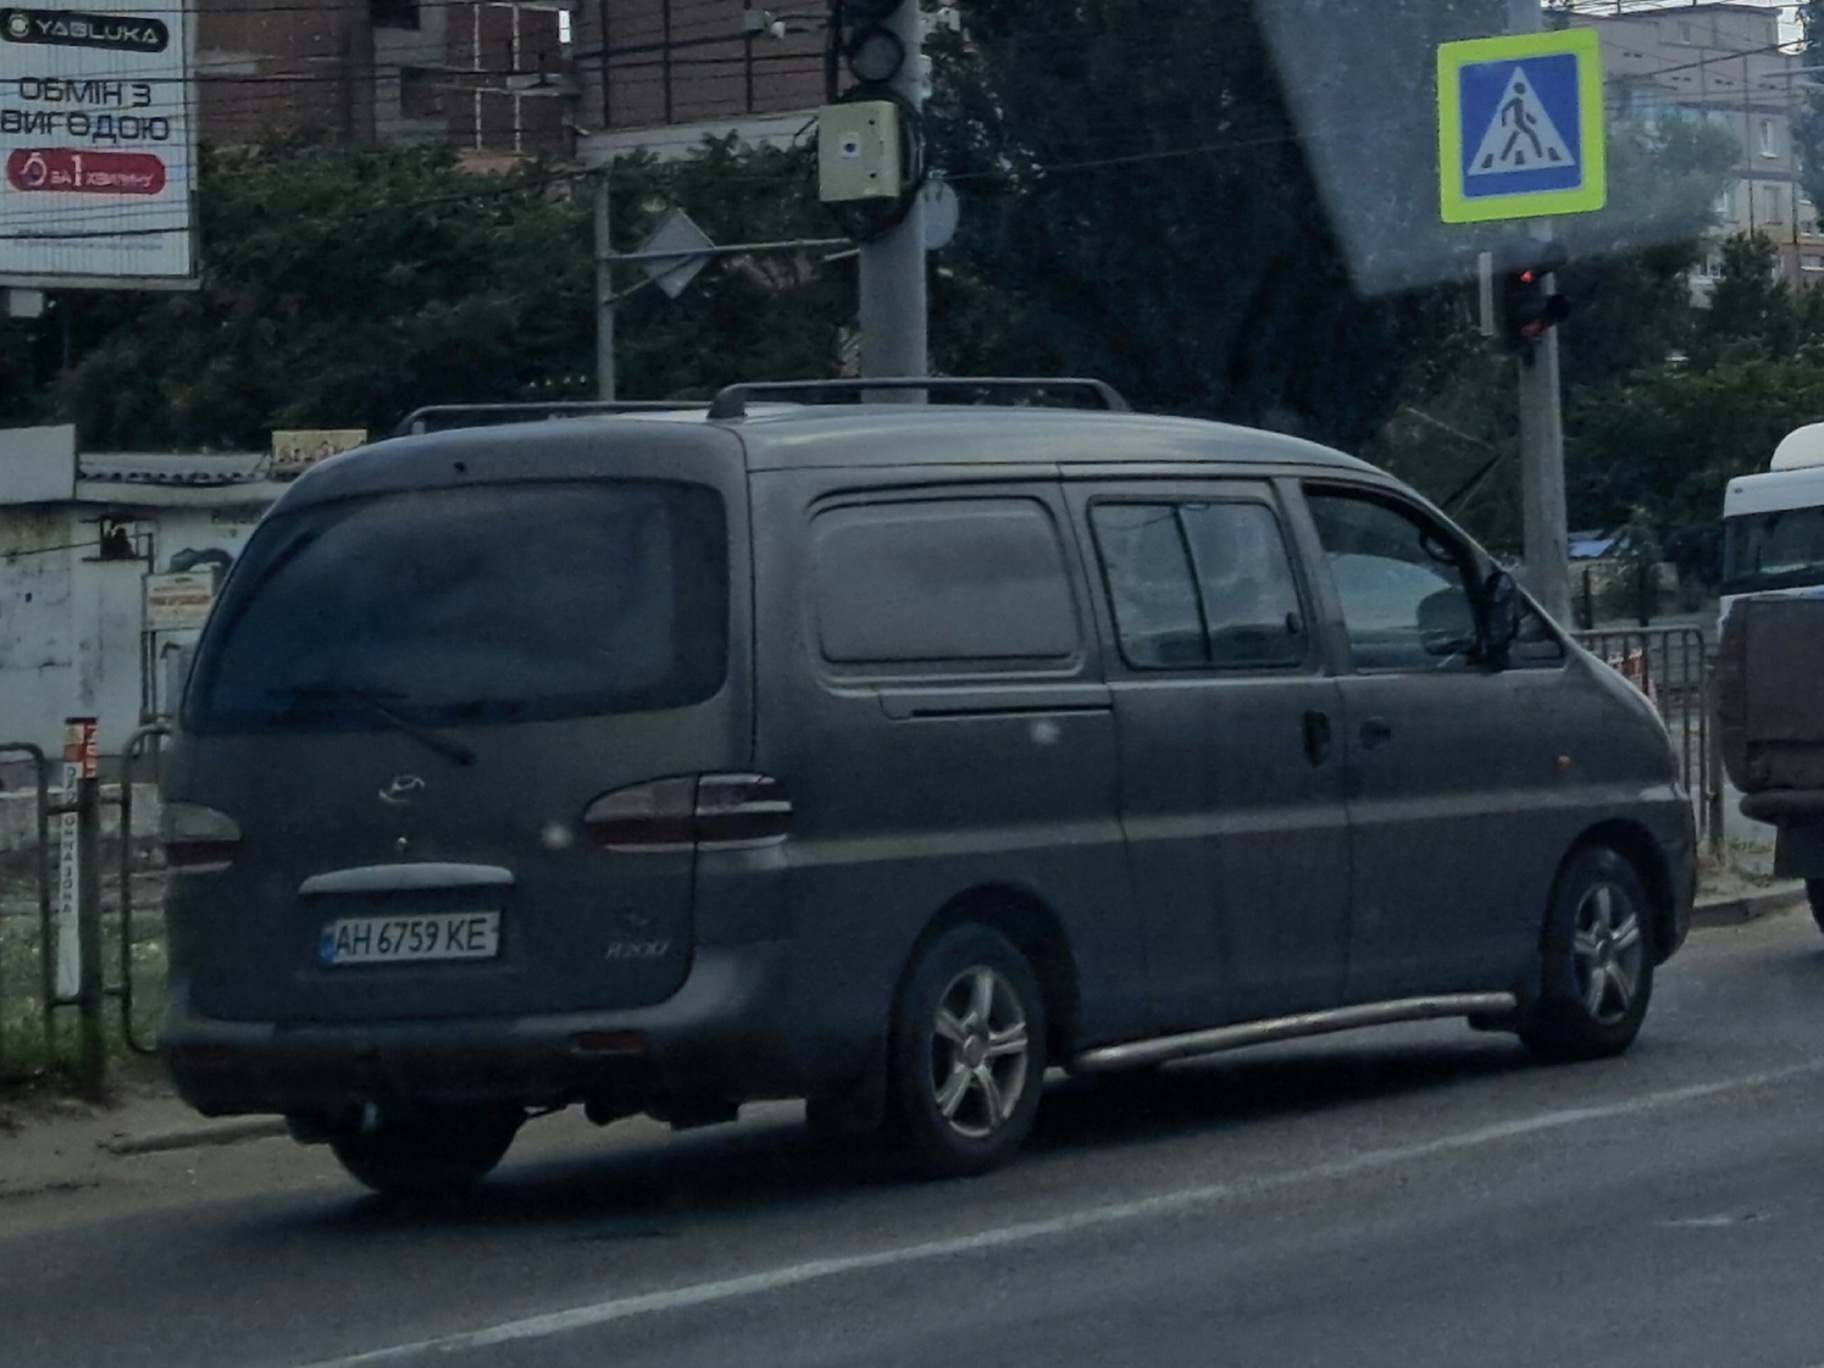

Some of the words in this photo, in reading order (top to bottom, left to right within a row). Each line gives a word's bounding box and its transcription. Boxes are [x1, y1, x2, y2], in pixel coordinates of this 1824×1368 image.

[36, 18, 160, 45] YABLUKA
[19, 77, 123, 106] ОБМІН
[131, 84, 151, 108] З
[0, 109, 170, 144] ВИГОДОЮ
[71, 154, 83, 188] 1
[335, 922, 372, 956] AH
[377, 920, 440, 954] 6759
[446, 917, 488, 951] KE
